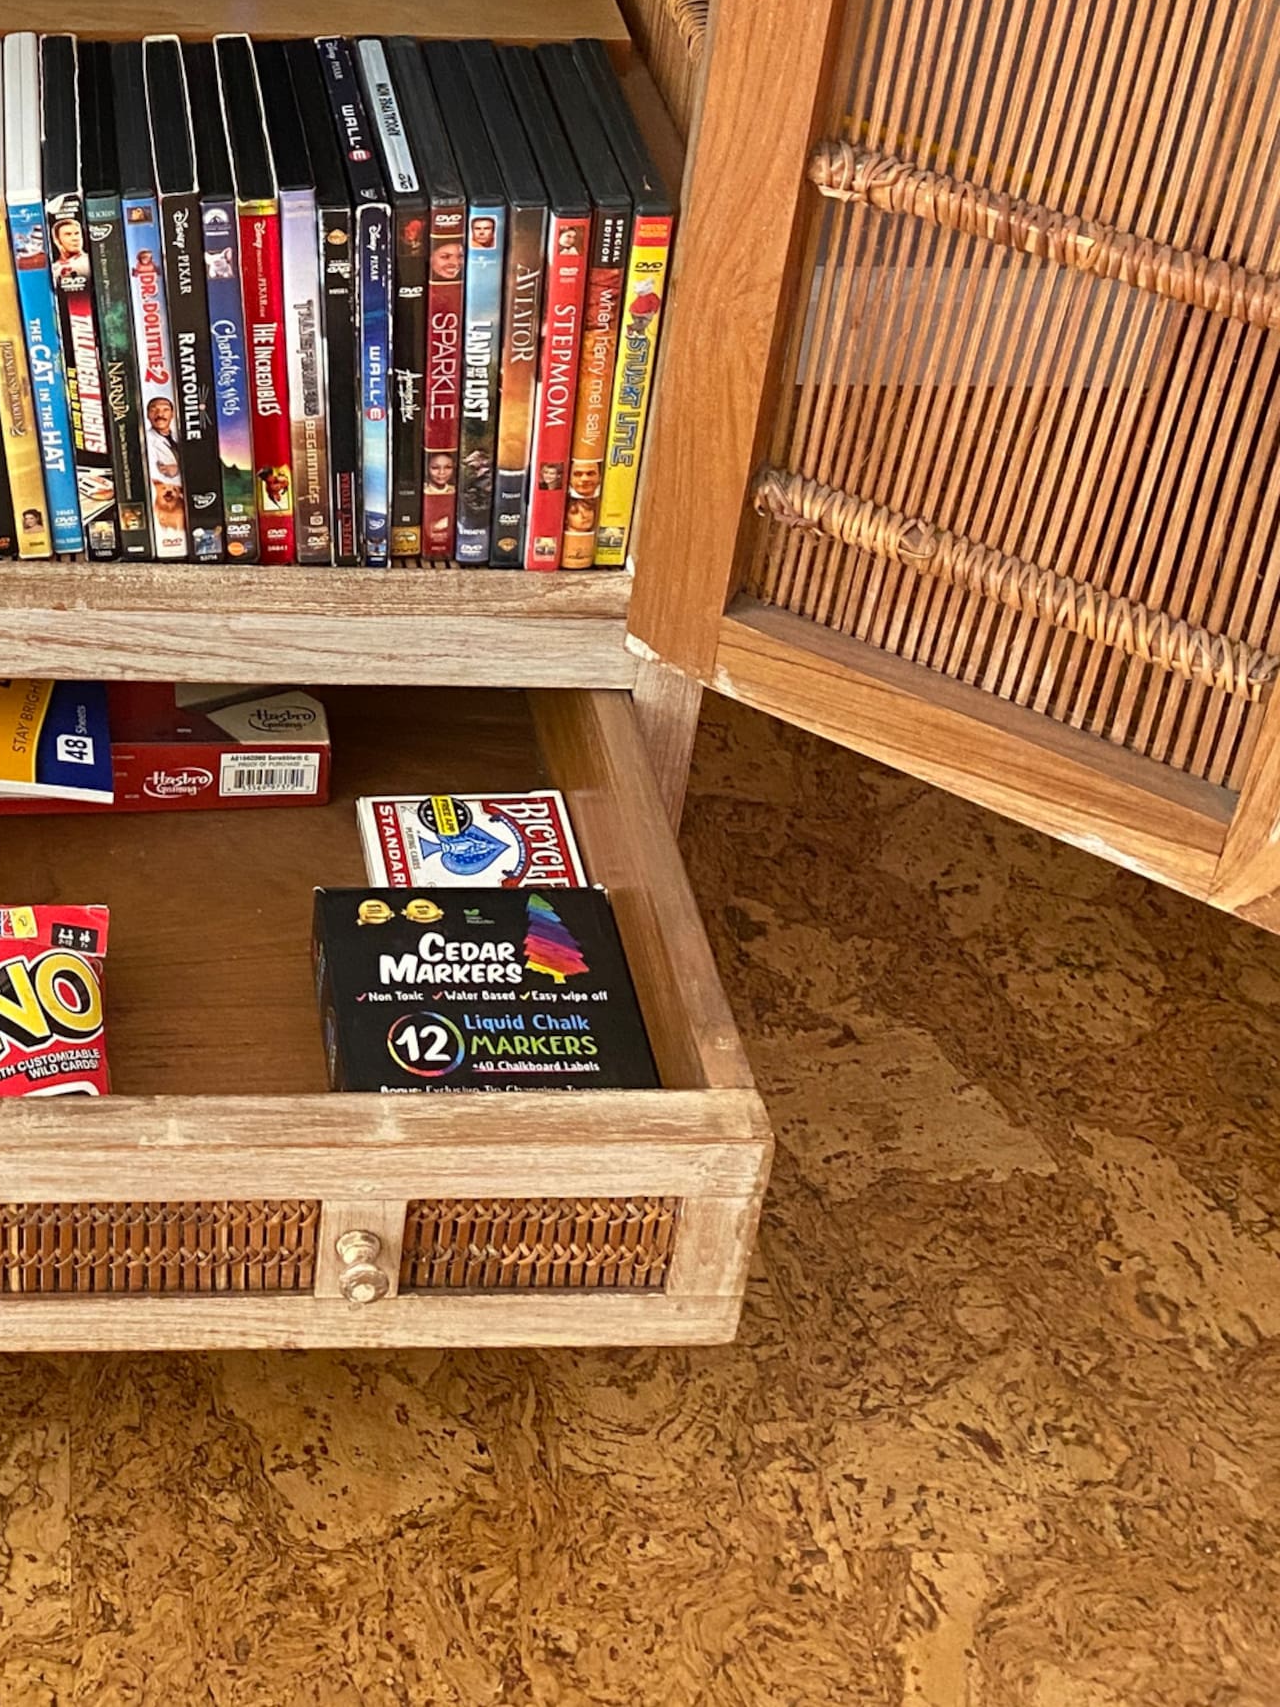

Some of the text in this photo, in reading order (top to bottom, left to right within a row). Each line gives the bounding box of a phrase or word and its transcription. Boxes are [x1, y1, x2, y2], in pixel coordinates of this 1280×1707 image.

[434, 213, 463, 226] DVD
[172, 208, 192, 295] Disney PIXAR
[366, 224, 382, 282] Disney PIXAR
[601, 219, 613, 263] EDITION
[612, 219, 624, 262] SPECIAL
[61, 276, 87, 288] DVD
[252, 220, 268, 305] Disney PIXAR
[634, 261, 664, 273] DVD
[139, 274, 170, 385] DR. DOLITTLE 2
[510, 263, 541, 364] AVIATOR
[465, 320, 492, 368] LAND
[70, 316, 109, 454] TALLADEGA NIGHTS
[211, 319, 241, 416] Charlotte's Web
[252, 322, 283, 417] THE INCREDIBLES
[430, 312, 459, 421] SPARKLE
[545, 304, 577, 428] STEPMOM
[581, 288, 614, 447] when harry met sally
[28, 317, 66, 473] THE CAT IN THE HAT
[107, 361, 131, 422] NARNIA
[177, 332, 202, 441] RATATOUILLE
[292, 298, 321, 505] TRANSFORMERS BEGINNINGS
[463, 379, 490, 422] LOST
[610, 334, 651, 467] STUART LITTLE
[340, 471, 353, 557] PERFECT STORM
[75, 704, 89, 735] Sheets
[250, 707, 315, 724] Hasbro
[261, 719, 304, 731] Gaming
[12, 724, 30, 754] STAY
[64, 738, 89, 761] 48
[145, 770, 211, 788] Hasbro
[156, 783, 199, 795] Gaming
[439, 798, 456, 834] FREE APP
[378, 804, 409, 888] STANDAR
[418, 932, 516, 962] CEDAR
[379, 953, 524, 985] MARKERS
[368, 991, 424, 1002] Non Toxic
[443, 990, 517, 1001] Water Based
[531, 990, 609, 1004] Easy wipe off
[395, 1025, 453, 1062] 12
[464, 1013, 591, 1034] Liquid Chalk
[16, 1047, 102, 1072] CUSTOMIZABLE
[470, 1035, 599, 1057] MARKERS
[28, 1058, 100, 1080] WILD CARDS!
[497, 1060, 562, 1072] Chalkboard
[564, 1061, 600, 1073] Labels
